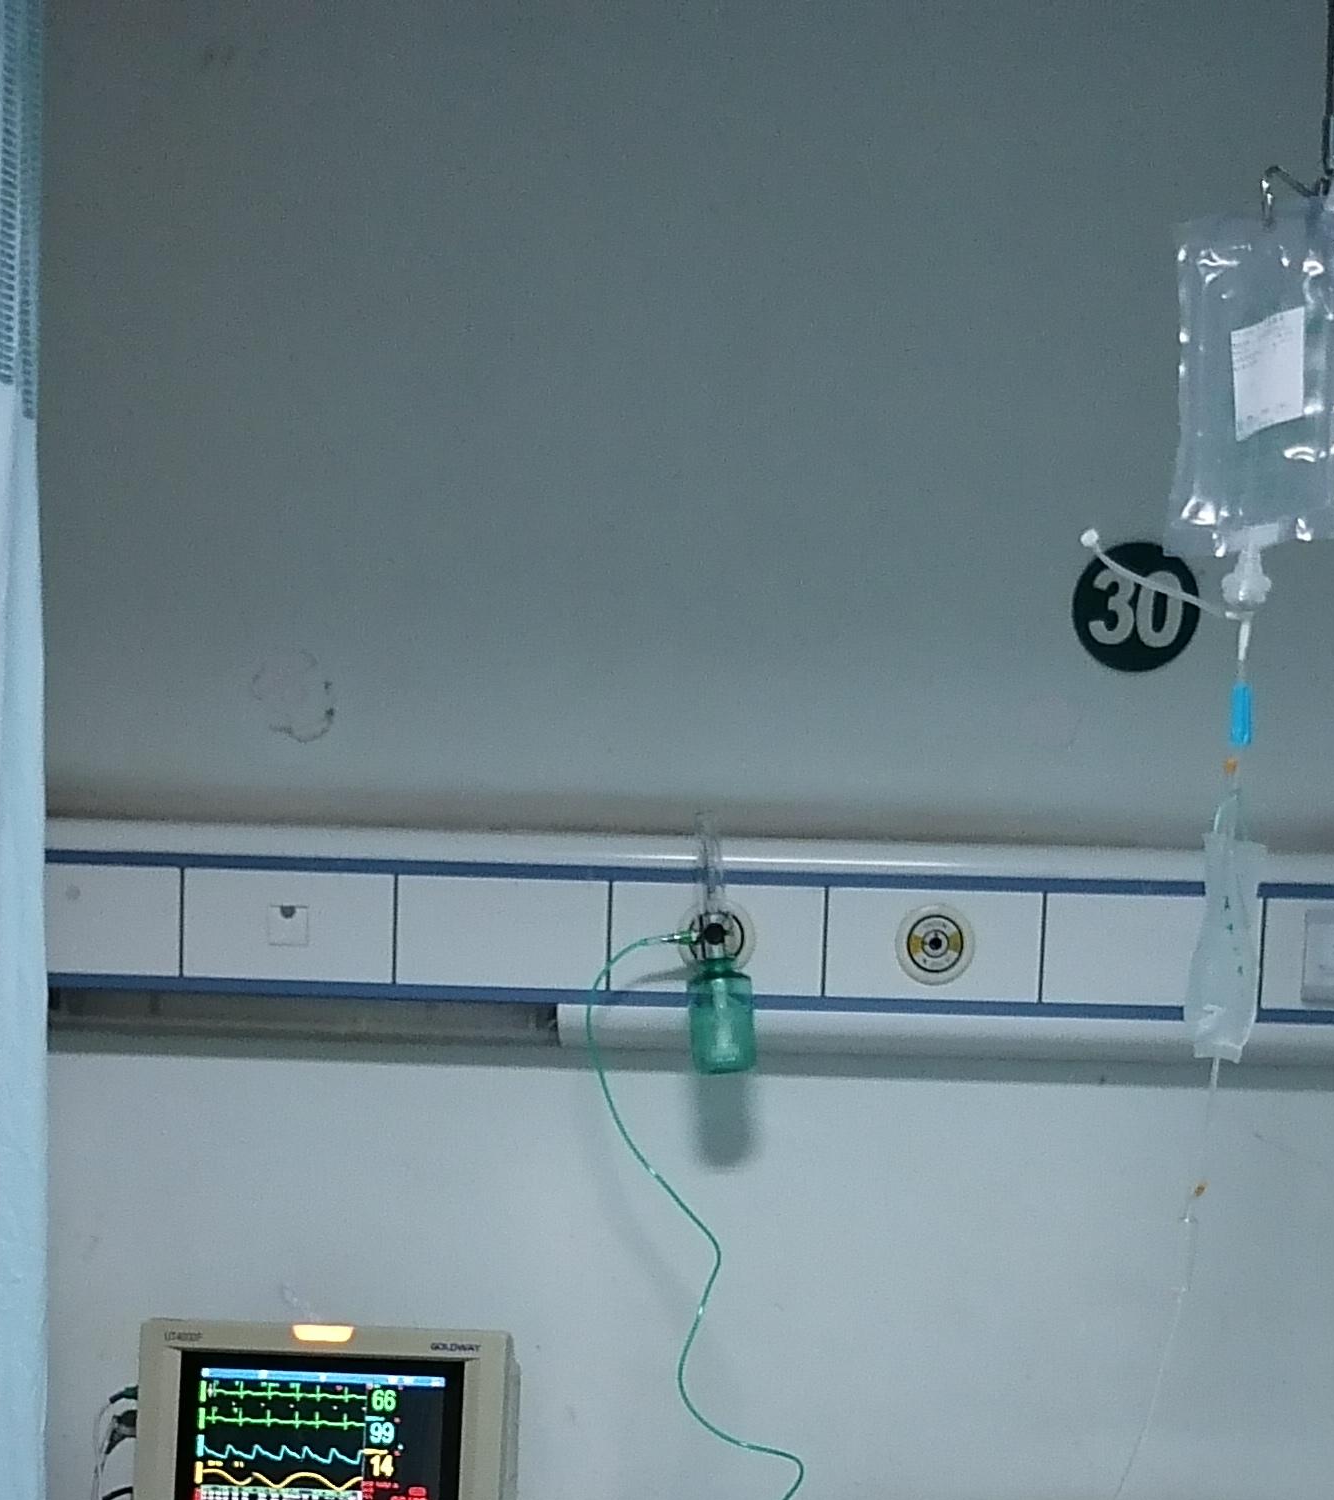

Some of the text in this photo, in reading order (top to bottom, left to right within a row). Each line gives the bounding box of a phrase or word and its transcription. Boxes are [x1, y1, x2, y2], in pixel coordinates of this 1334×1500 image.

[1088, 567, 1184, 649] 30
[371, 1389, 397, 1412] 66
[369, 1421, 395, 1445] 99
[370, 1454, 394, 1477] 14
